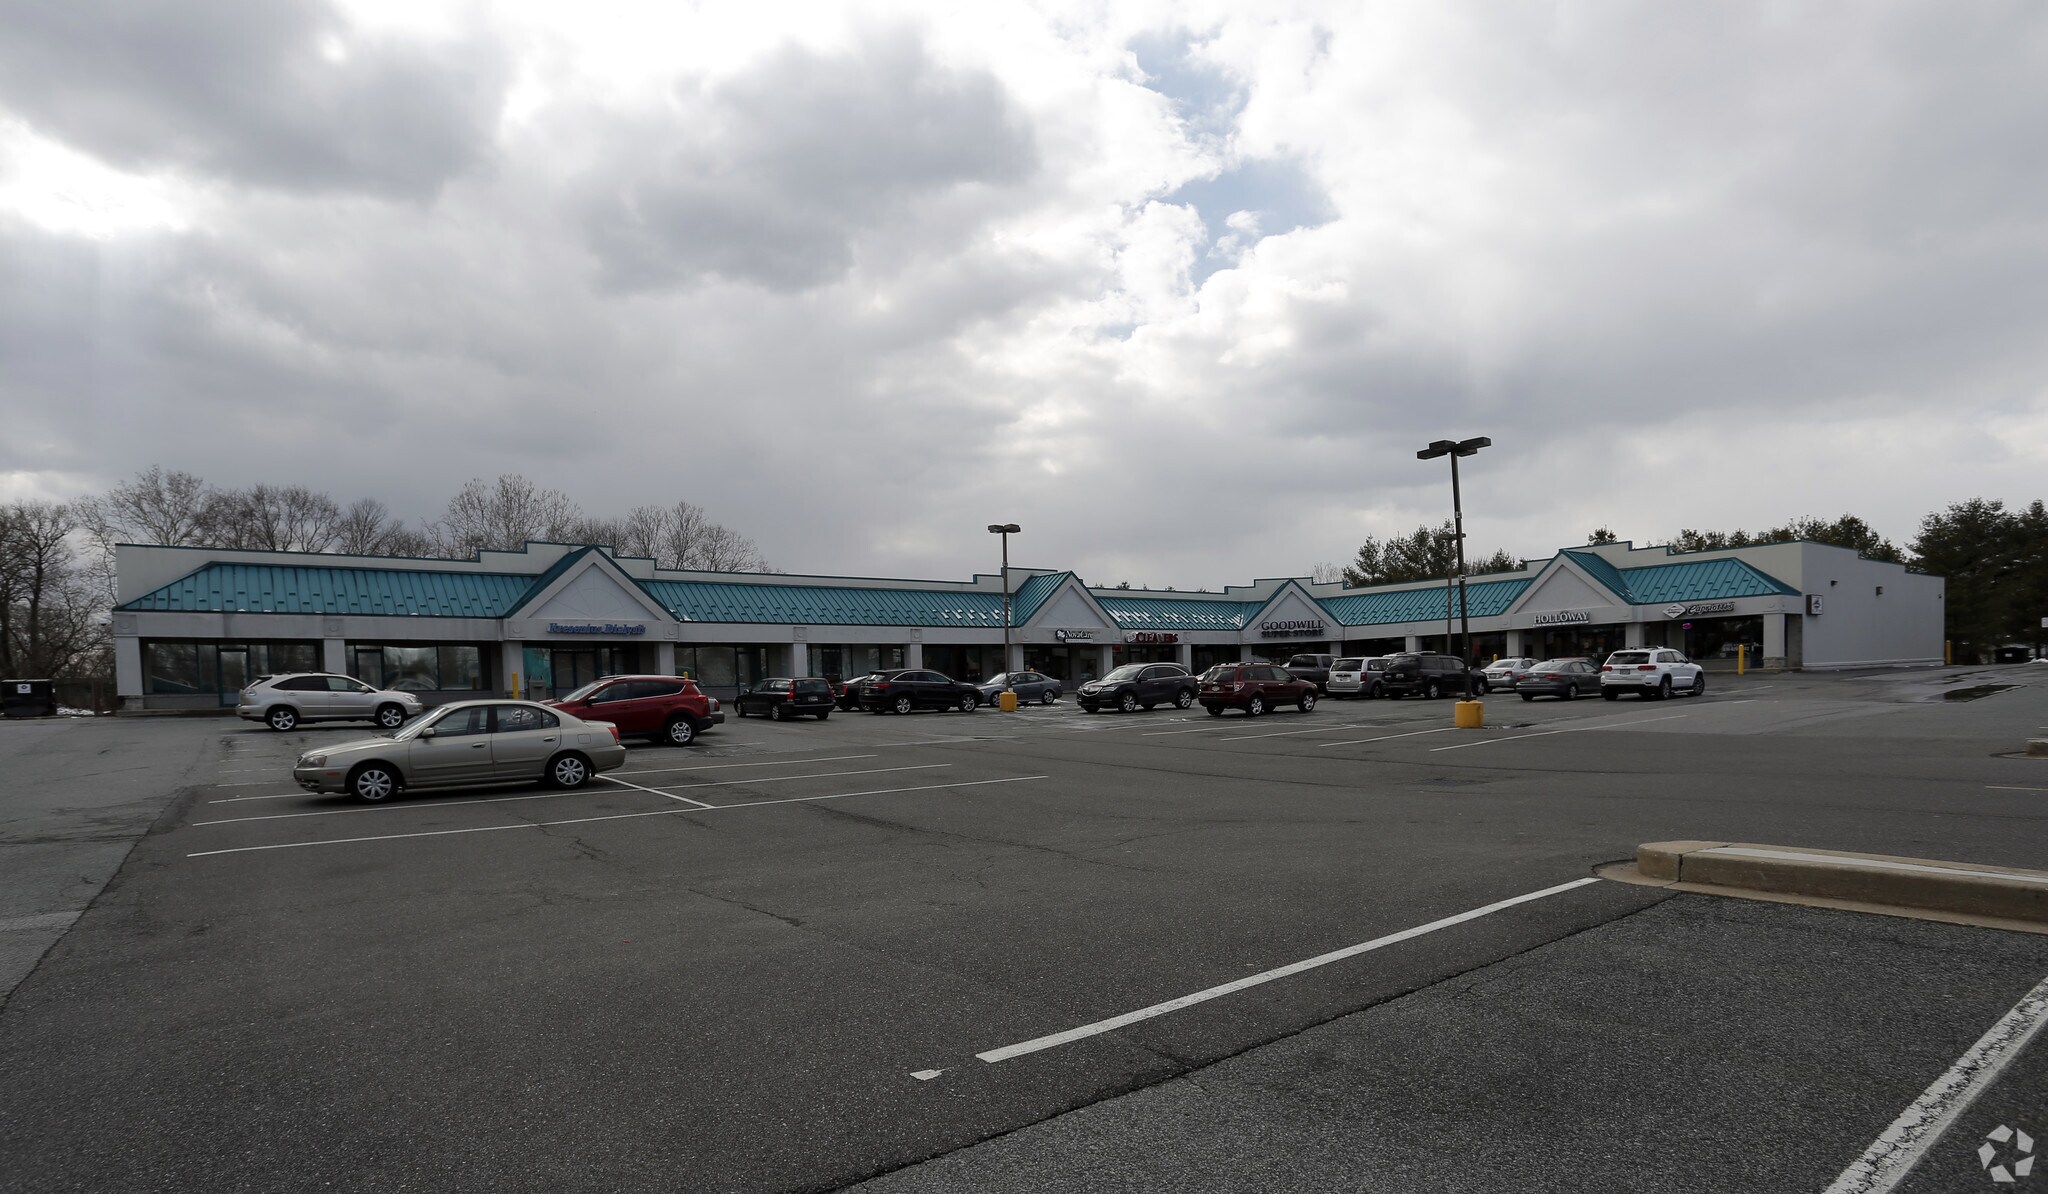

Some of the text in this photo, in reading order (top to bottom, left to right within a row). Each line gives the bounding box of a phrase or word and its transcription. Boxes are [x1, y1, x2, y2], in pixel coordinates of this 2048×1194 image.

[1533, 611, 1589, 624] HOLLOWAY
[1261, 620, 1325, 631] GOODWILL
[1136, 631, 1179, 643] CLEANERS
[1261, 628, 1325, 638] SUPER STORE
